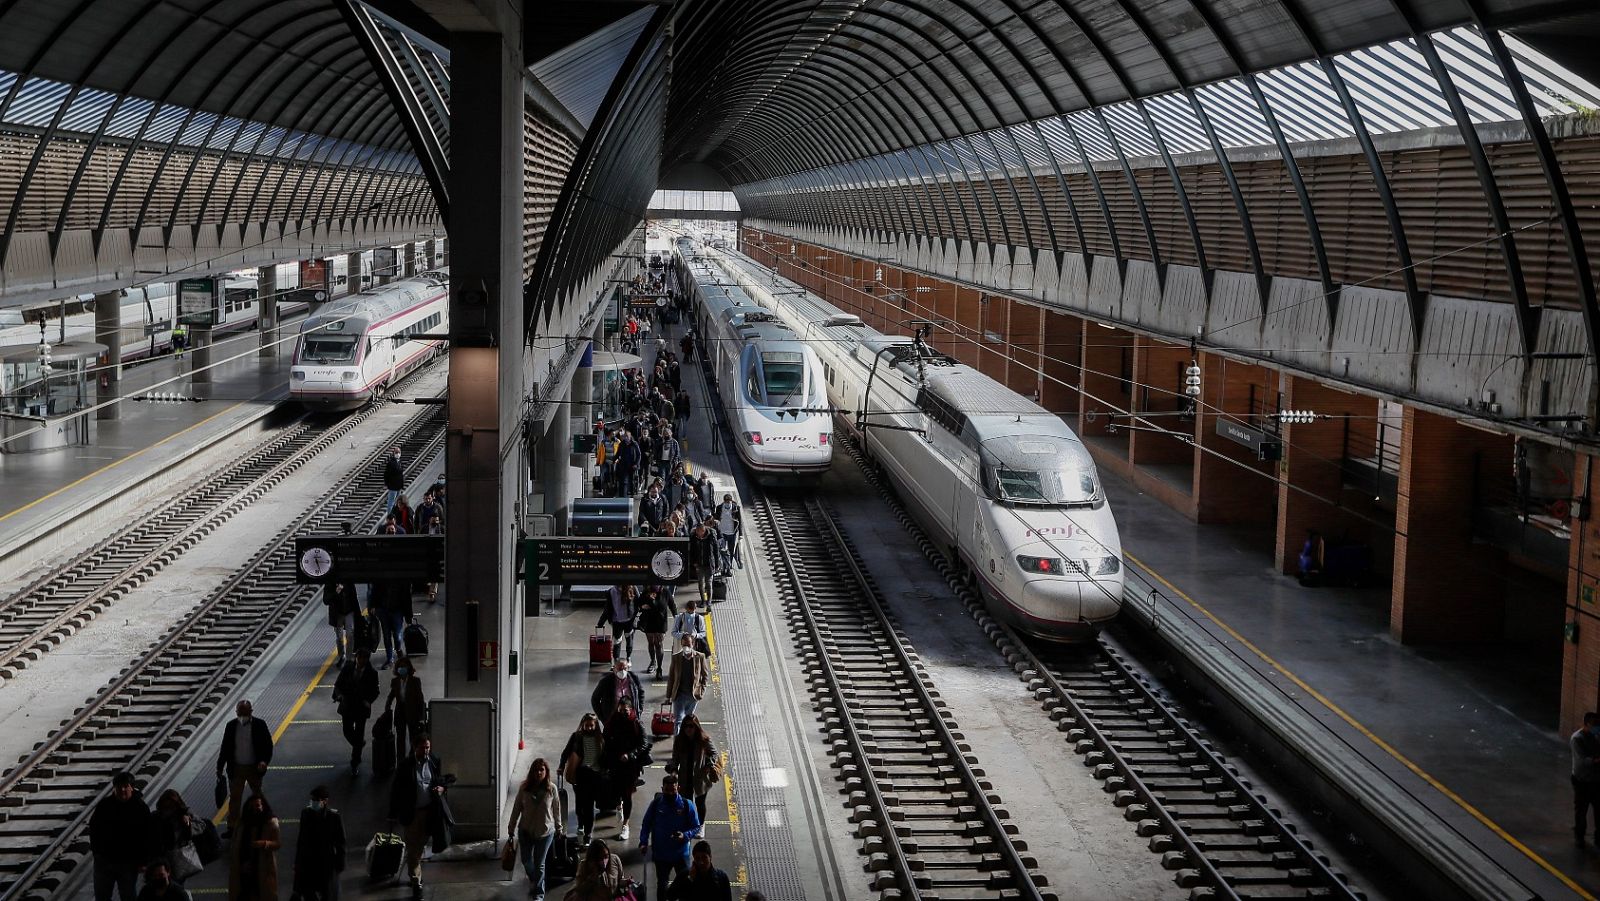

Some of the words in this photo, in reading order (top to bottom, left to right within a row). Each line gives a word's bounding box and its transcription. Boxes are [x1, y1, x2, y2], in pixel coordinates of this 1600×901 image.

[765, 434, 807, 443] renfe
[1025, 524, 1089, 539] renfe
[538, 562, 550, 581] 2
